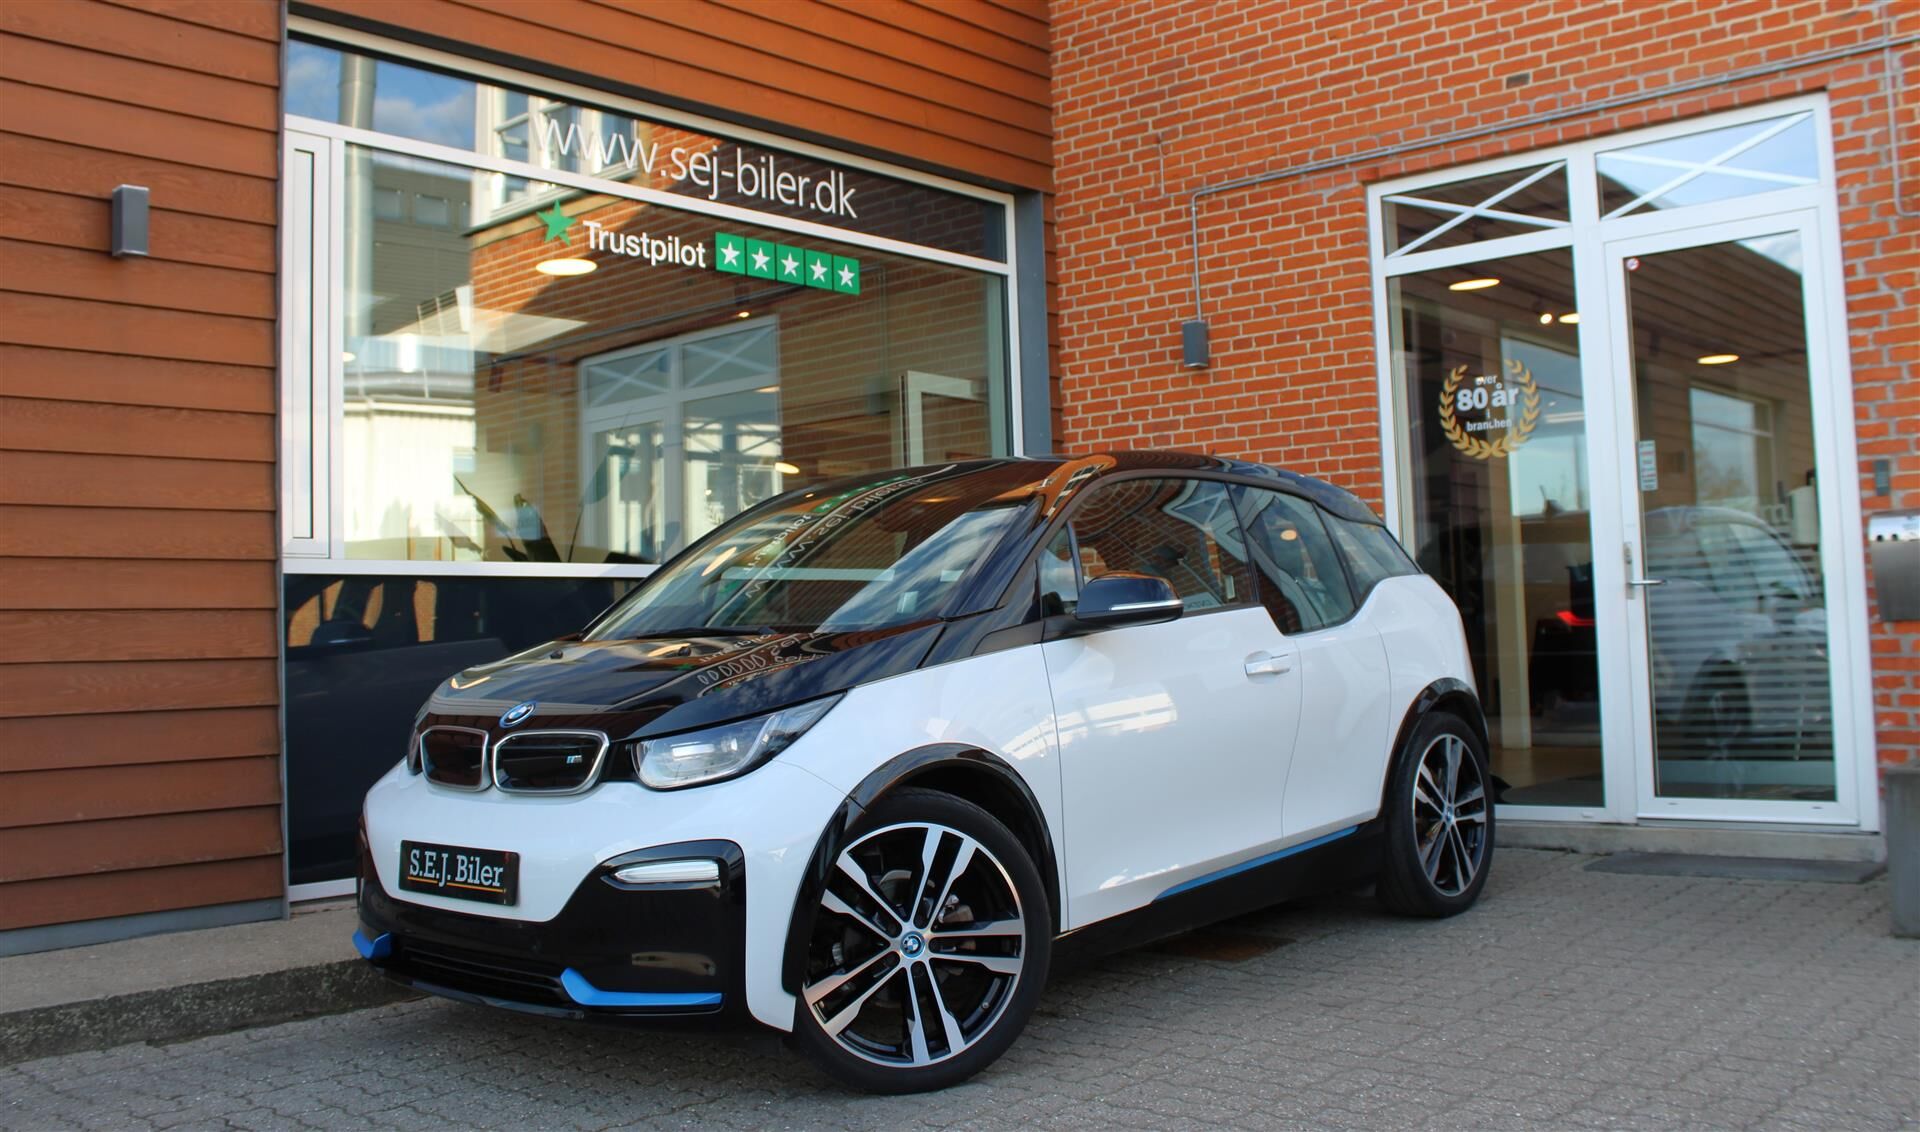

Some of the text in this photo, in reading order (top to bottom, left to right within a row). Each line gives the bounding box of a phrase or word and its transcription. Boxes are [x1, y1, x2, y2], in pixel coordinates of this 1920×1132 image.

[533, 115, 857, 218] www.sej-biler.dk
[582, 220, 706, 268] Trustpilot
[1457, 382, 1519, 411] 80 år
[409, 849, 504, 887] S.E.J. Biler
